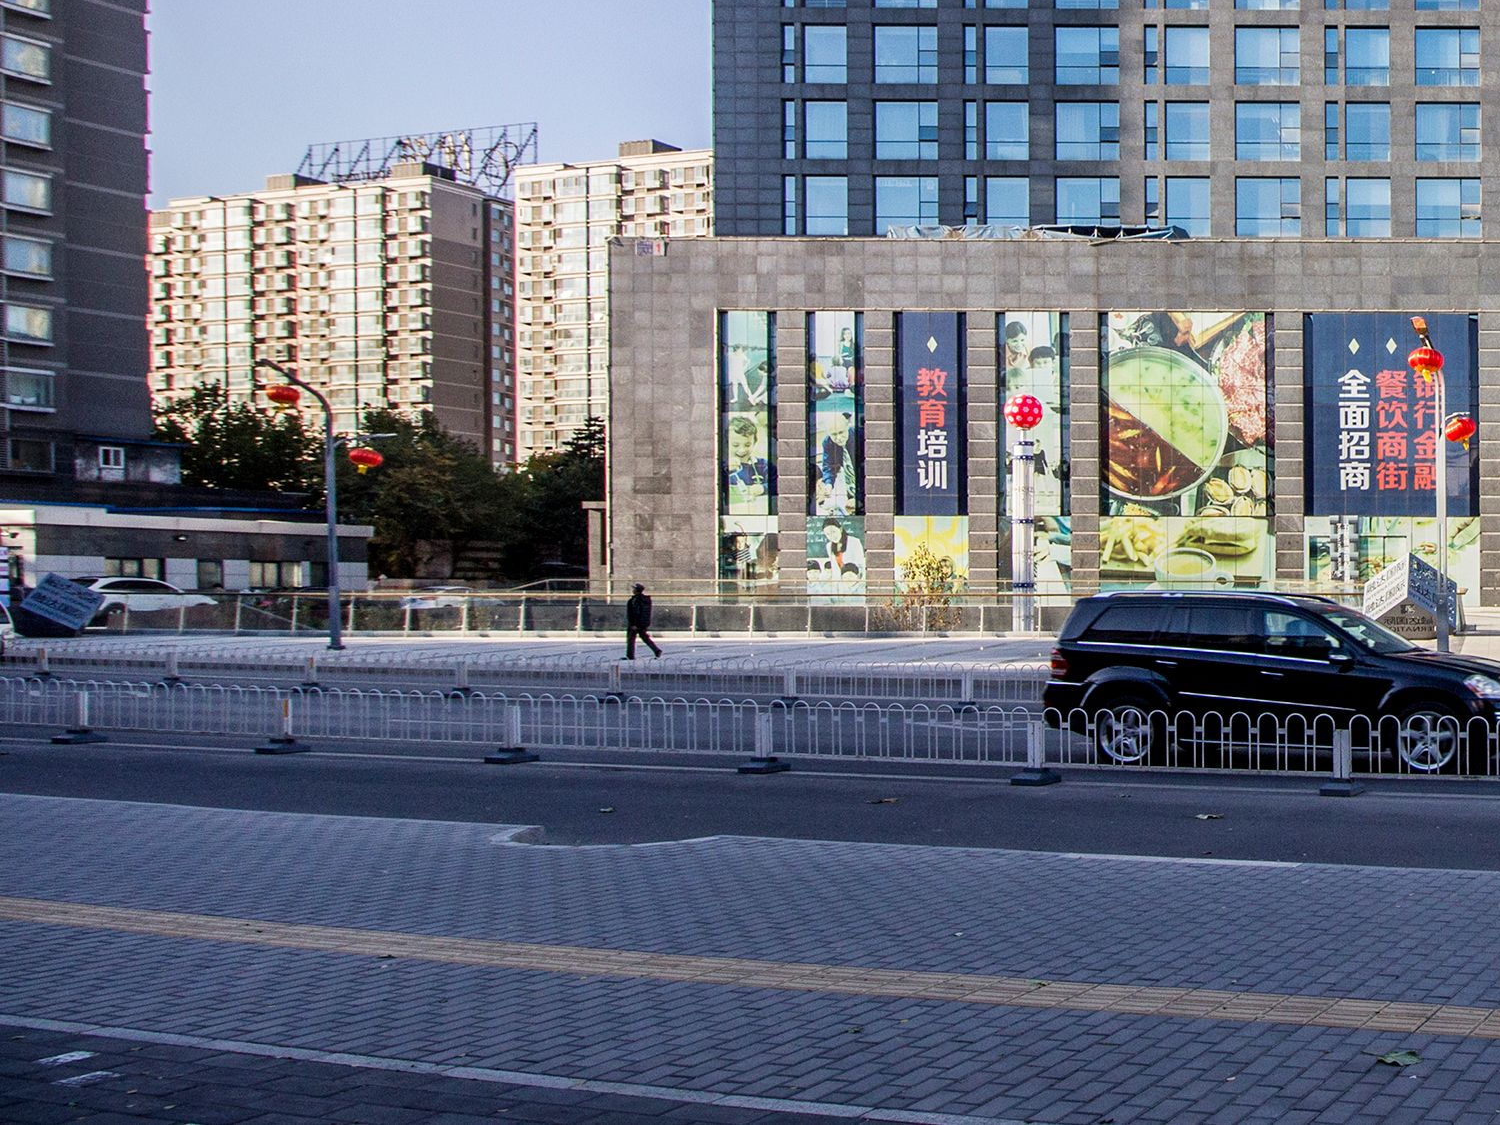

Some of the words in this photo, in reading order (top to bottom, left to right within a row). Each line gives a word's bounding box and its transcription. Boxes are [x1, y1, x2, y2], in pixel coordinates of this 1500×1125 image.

[917, 367, 948, 489] 教育培训
[1338, 369, 1371, 490] 全面招商
[1376, 369, 1408, 491] 餐饮商街
